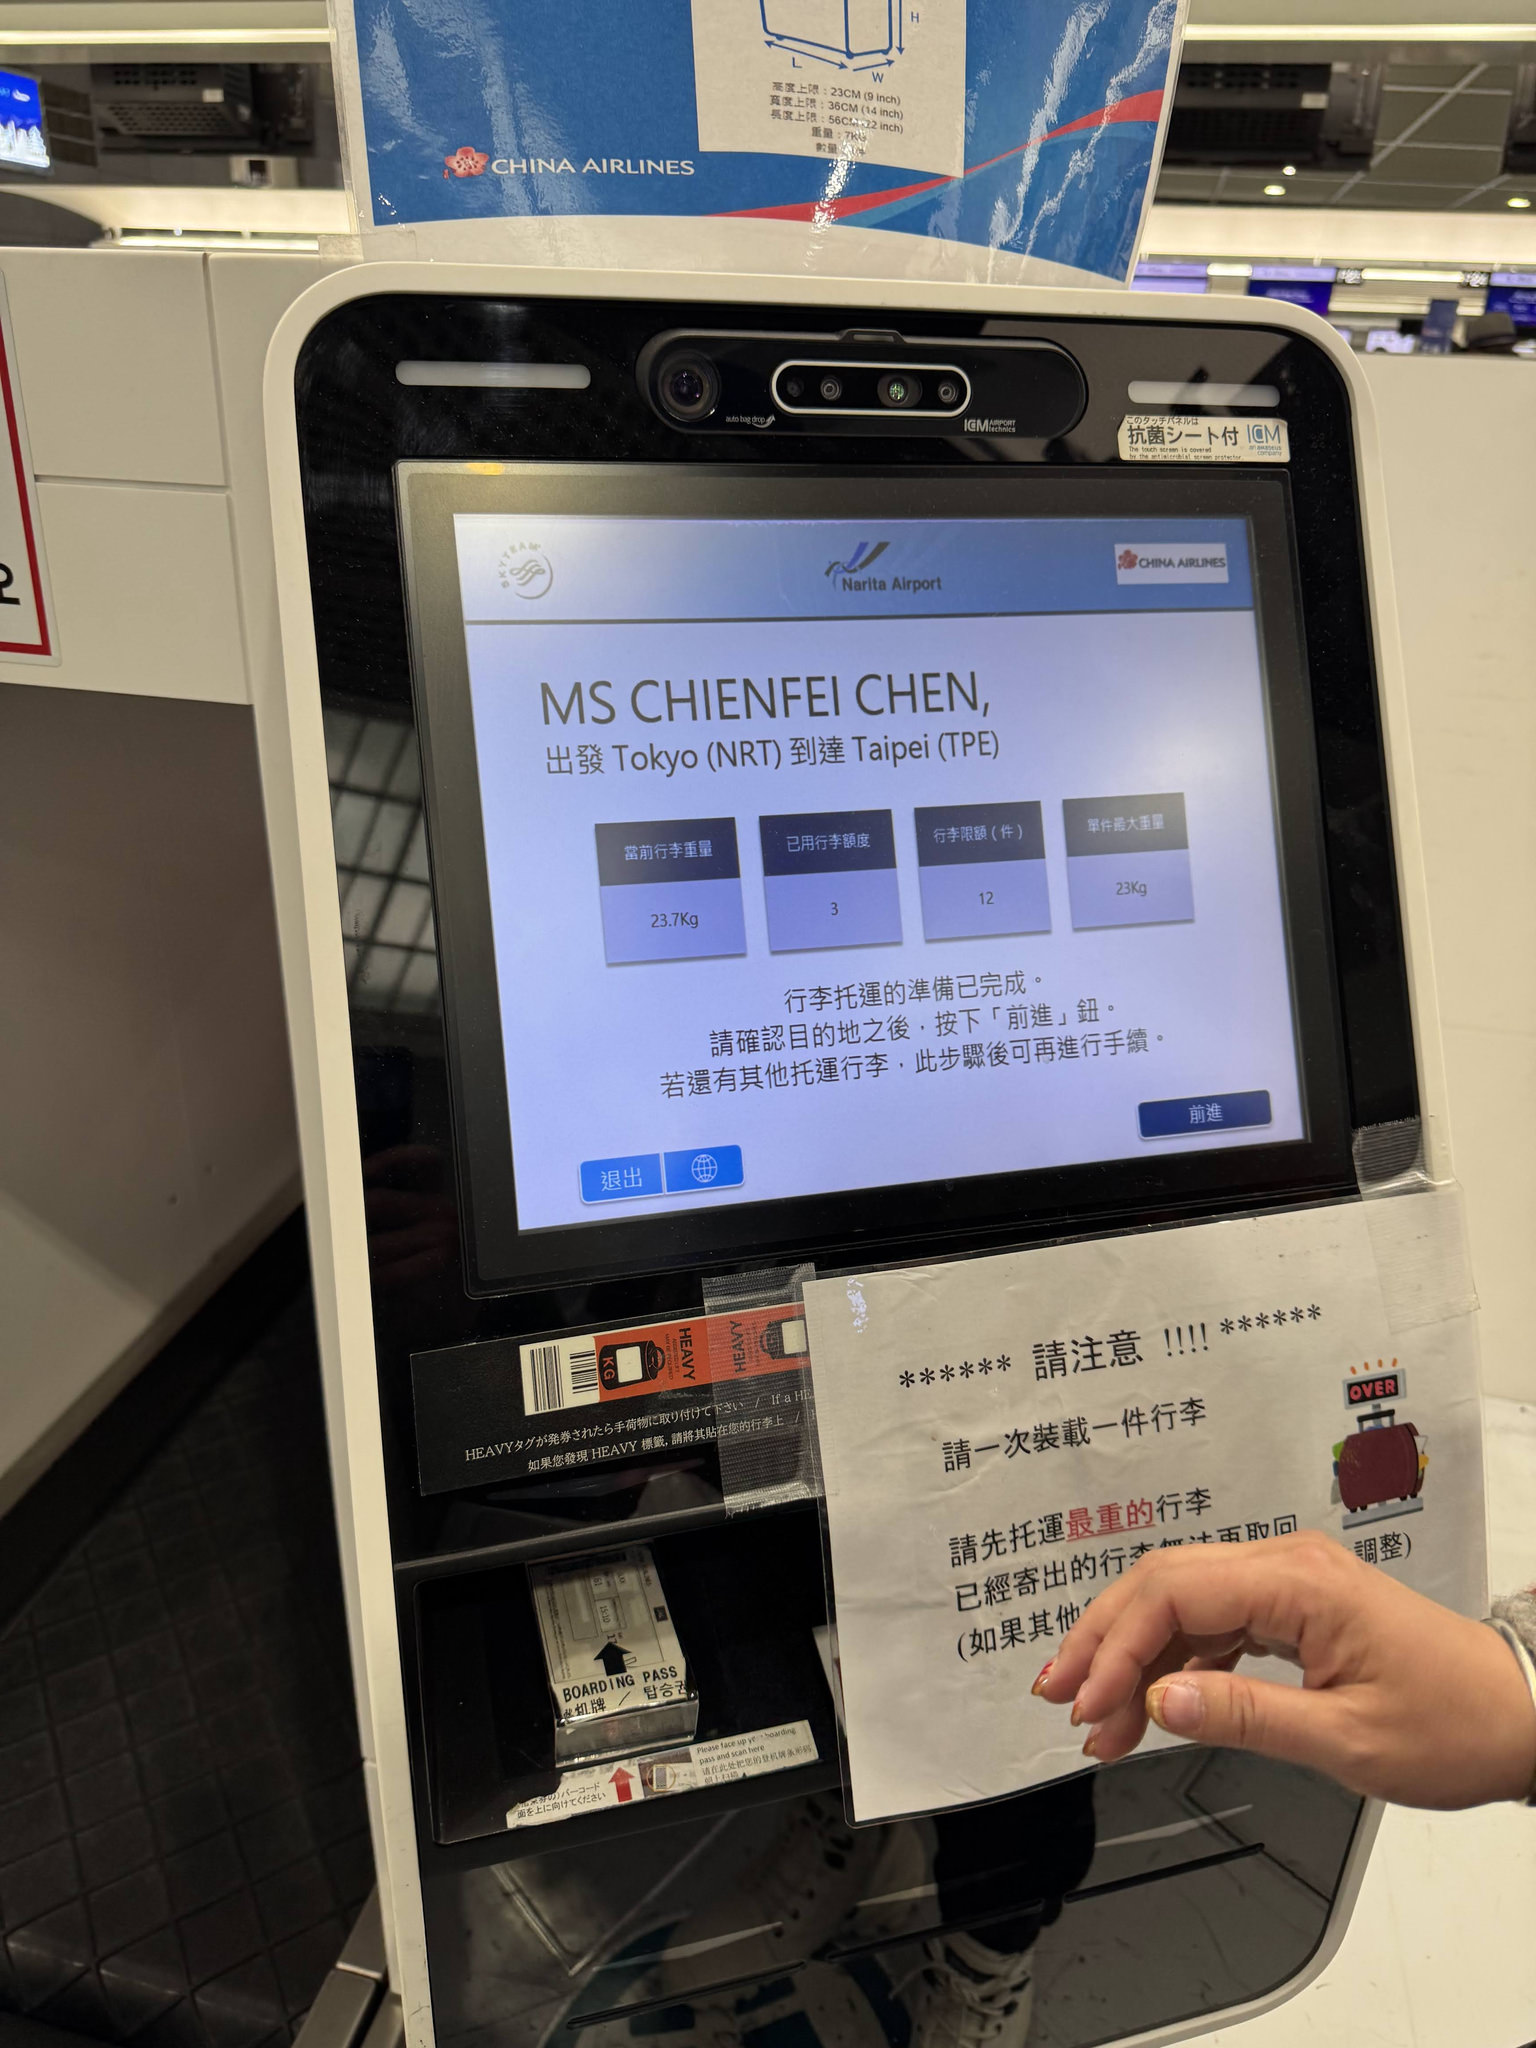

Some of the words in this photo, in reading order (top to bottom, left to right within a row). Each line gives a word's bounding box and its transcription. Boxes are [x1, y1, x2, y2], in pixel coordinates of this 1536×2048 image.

[911, 11, 920, 23] H
[792, 56, 803, 69] L
[872, 71, 884, 83] W
[876, 92, 901, 106] inch)
[879, 107, 904, 120] inch)
[880, 122, 904, 135] inch)
[491, 158, 576, 175] CHINA
[582, 158, 695, 176] AIRLINES
[1127, 425, 1239, 446] 抗菌シート付
[1138, 558, 1175, 568] CHINA
[1177, 557, 1226, 568] AIRLINES
[842, 577, 887, 592] Narita
[892, 577, 942, 594] Airport
[540, 680, 616, 725] MS
[631, 676, 841, 724] CHIENFEI
[856, 671, 990, 717] CHEN,
[546, 744, 605, 776] 出發
[612, 743, 698, 778] Tokyo
[706, 739, 782, 772] (NRT)
[790, 735, 845, 767] 到達
[851, 733, 930, 768] Taipei
[937, 730, 1000, 763] (TPE)
[624, 840, 713, 861] 當前行李重量
[786, 832, 871, 853] 已用行李額度
[979, 891, 994, 905] 12
[1116, 881, 1148, 897] 23Kg
[830, 902, 839, 916] 3
[651, 912, 699, 929] 23.7Kg
[1188, 1103, 1223, 1124] 前進
[600, 1167, 643, 1192] 退出
[679, 1327, 696, 1380] HEAVY
[730, 1320, 747, 1373] HEAVY
[1032, 1328, 1145, 1381] 請注意
[602, 1356, 616, 1380] KG
[794, 1388, 814, 1401] HE
[1350, 1378, 1395, 1401] OVER
[942, 1396, 1207, 1473] 請一次裝載一件行李
[591, 1440, 638, 1460] HEAVY
[949, 1487, 1212, 1568] 請先托運最重的行李
[957, 1597, 1096, 1663] (如果其他
[562, 1675, 635, 1703] BOARDING
[642, 1666, 678, 1683] PASS
[697, 1744, 720, 1754] Please
[720, 1741, 736, 1749] face
[699, 1756, 716, 1766] pass
[717, 1751, 731, 1761] and
